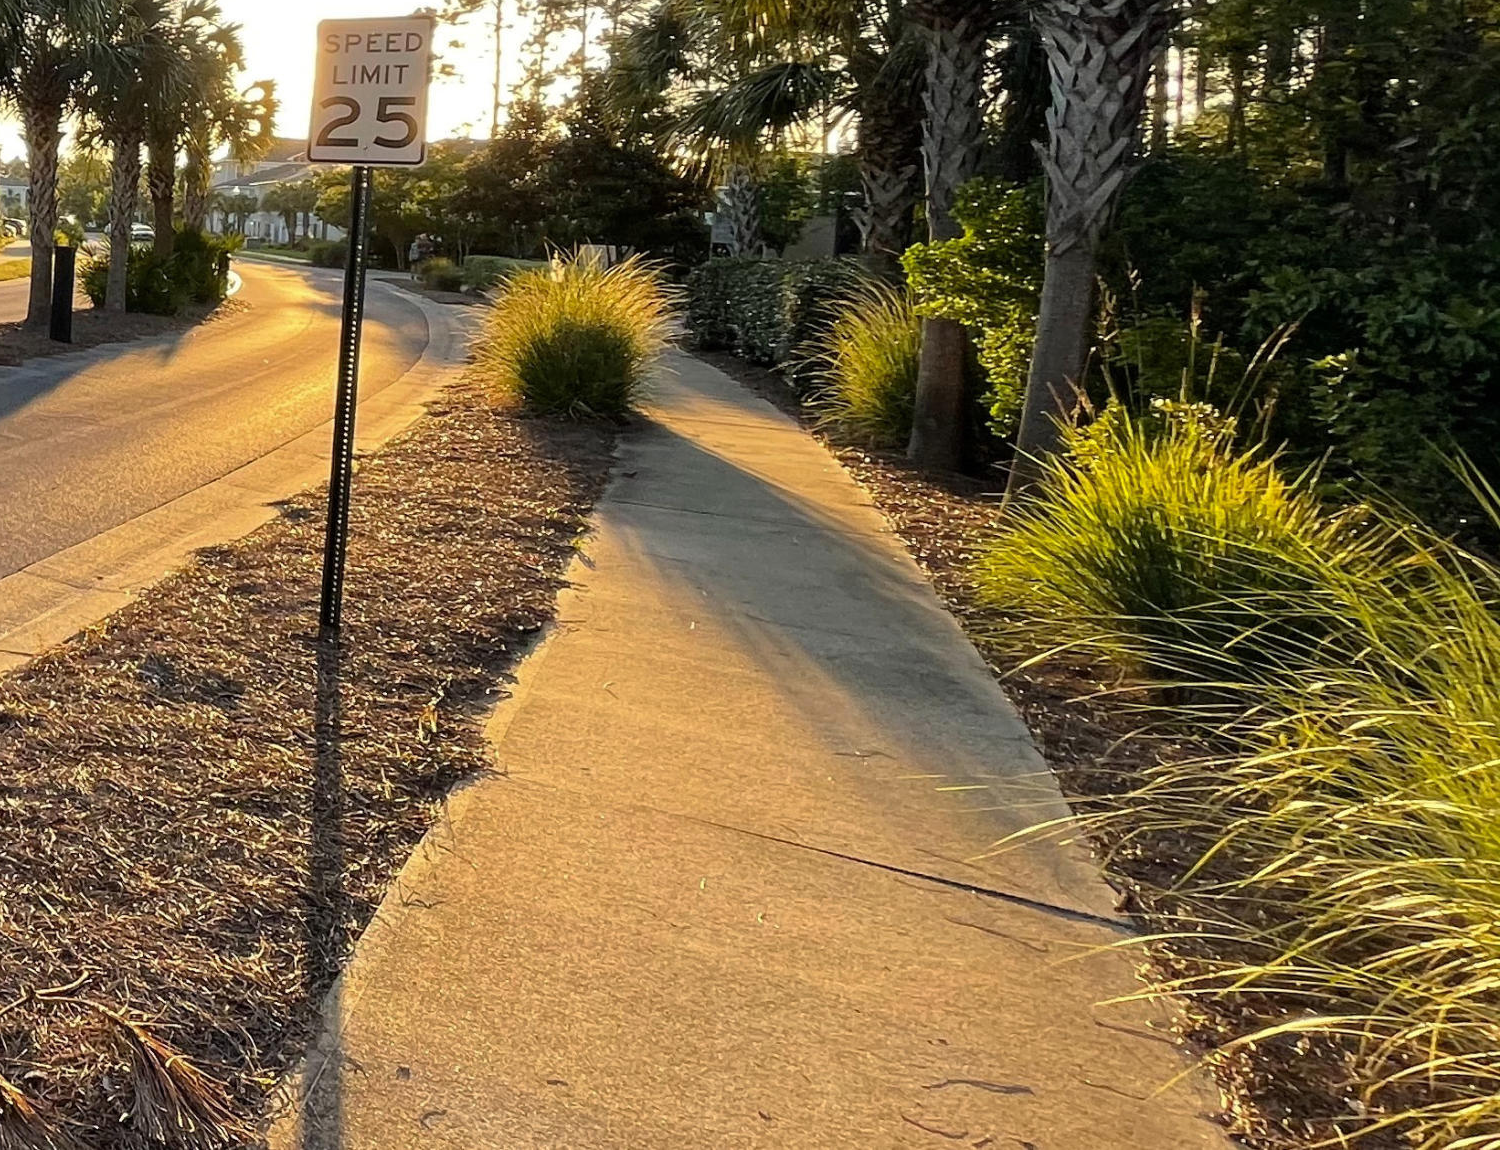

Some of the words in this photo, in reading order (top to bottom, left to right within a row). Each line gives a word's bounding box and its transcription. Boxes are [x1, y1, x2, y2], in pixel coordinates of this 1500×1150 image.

[324, 32, 423, 54] SPEED
[332, 64, 409, 85] LIMIT
[315, 96, 418, 149] 25
